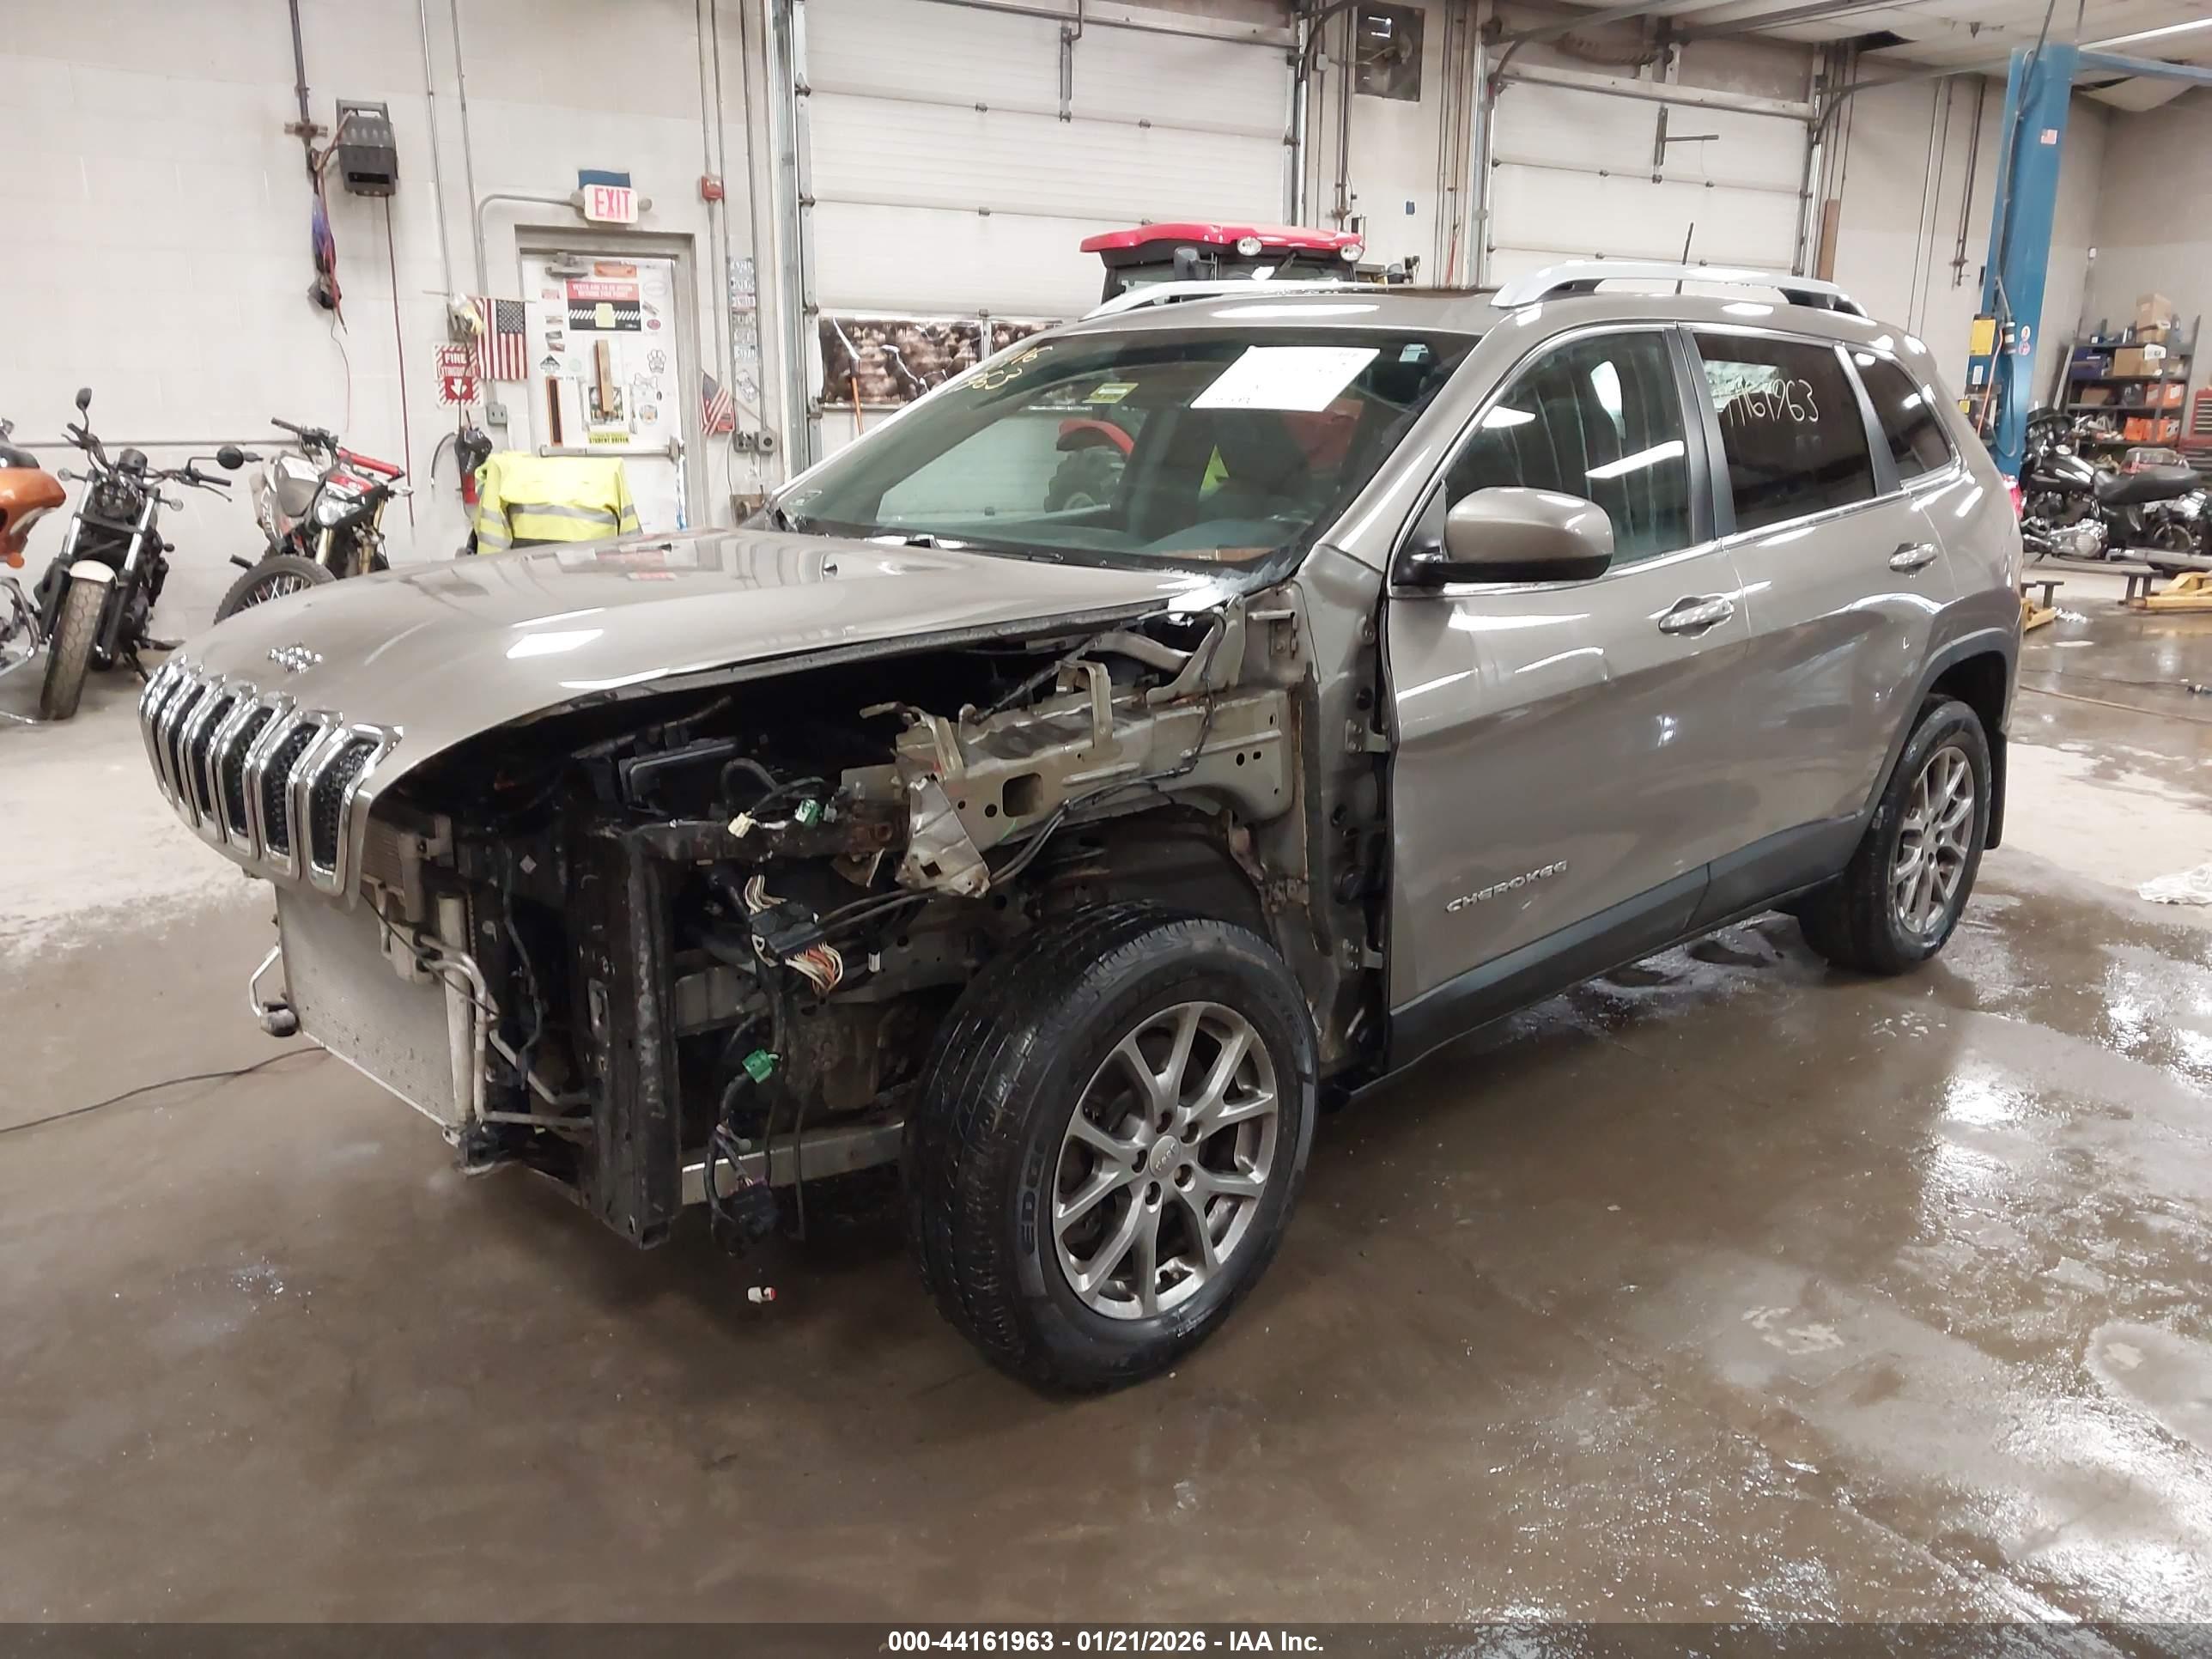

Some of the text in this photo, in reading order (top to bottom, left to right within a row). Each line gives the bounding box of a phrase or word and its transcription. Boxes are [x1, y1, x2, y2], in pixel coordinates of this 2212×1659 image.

[594, 188, 630, 220] EXIT
[444, 352, 467, 364] FIRE
[1446, 860, 1567, 913] CHEROKEE
